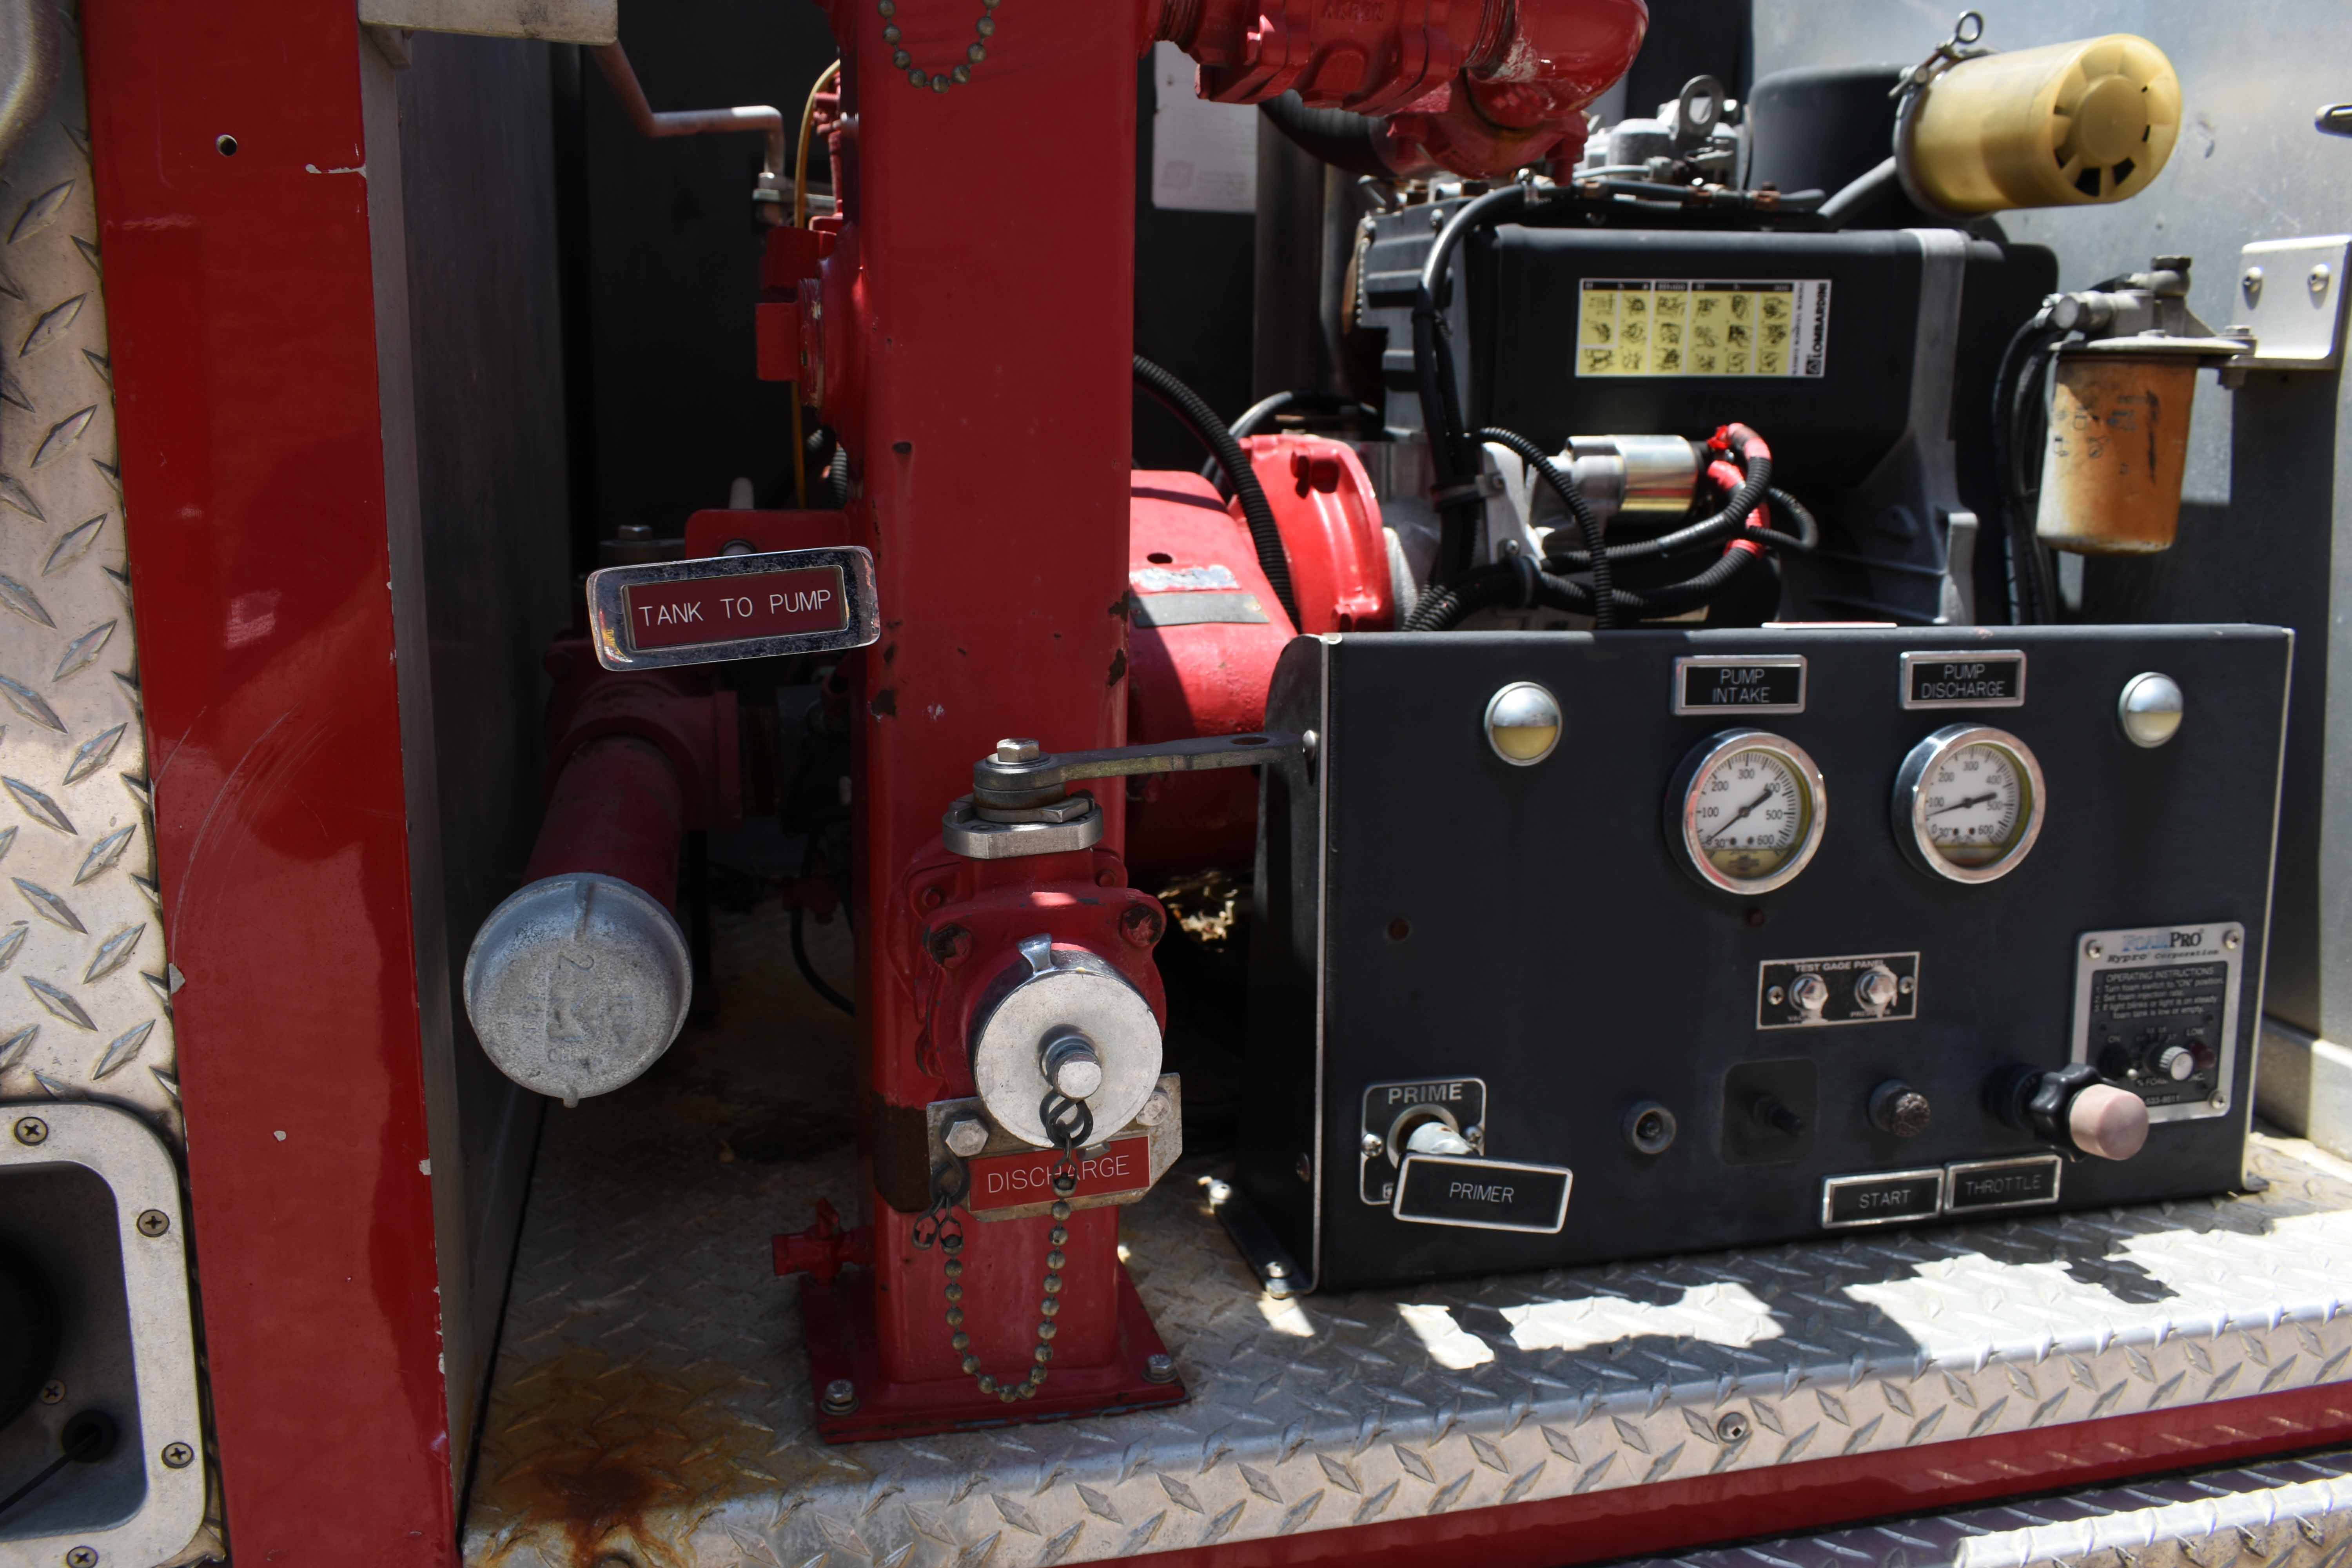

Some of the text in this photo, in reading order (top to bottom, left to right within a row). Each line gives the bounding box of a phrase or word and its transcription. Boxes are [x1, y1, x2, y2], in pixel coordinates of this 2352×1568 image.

[1813, 283, 1827, 358] LOMBARDINI
[638, 589, 831, 626] TANK TO PUMP
[1720, 669, 1765, 684] PUMP
[1944, 664, 1985, 679] PUMP
[1712, 687, 1771, 703] INTAKE
[1922, 681, 2005, 698] DISCHARGE
[1962, 760, 1979, 771] 300
[1737, 768, 1755, 780] 300
[1938, 771, 1955, 783] 200
[1985, 774, 2002, 785] 400
[1711, 780, 1729, 792] 200
[1763, 782, 1781, 793] 400
[1928, 797, 1945, 808] 100
[1986, 800, 2003, 811] 500
[1702, 807, 1719, 818] 100
[1765, 809, 1783, 820] 500
[1931, 824, 1938, 834] 0
[1978, 825, 1994, 835] 600
[1757, 835, 1775, 845] 600
[2107, 949, 2220, 963] Hypro Corporation
[1795, 963, 1821, 972] TEST
[1823, 961, 1851, 971] GAGE
[2106, 966, 2214, 982] OPERATING INSTRUCTIONS
[1388, 1083, 1463, 1105] PRIME
[987, 1155, 1130, 1194] DISCHARGE
[1965, 1174, 2042, 1196] THROTTLE
[1449, 1181, 1514, 1203] PRIMER
[1858, 1189, 1911, 1209] START
